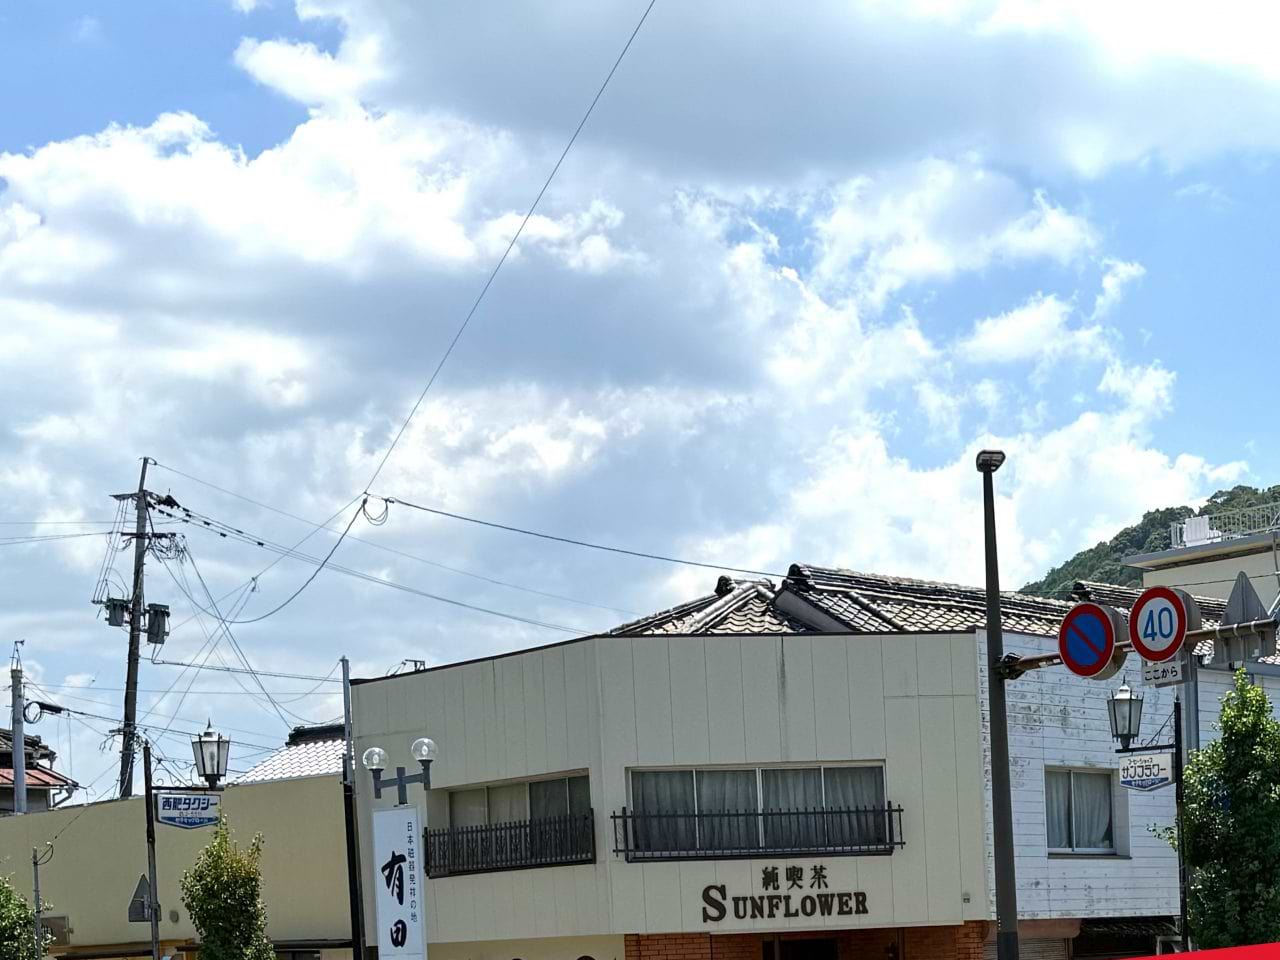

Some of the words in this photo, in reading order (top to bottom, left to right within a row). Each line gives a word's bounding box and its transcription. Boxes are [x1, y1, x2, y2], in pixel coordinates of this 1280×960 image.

[1143, 606, 1174, 642] 40
[1144, 666, 1178, 681] ここから
[1121, 763, 1167, 779] サンフラワー
[161, 797, 218, 811] 西肥タクシー
[761, 864, 829, 891] 純喫茶
[381, 850, 407, 948] 有田
[701, 884, 869, 923] SUNFLOWER
